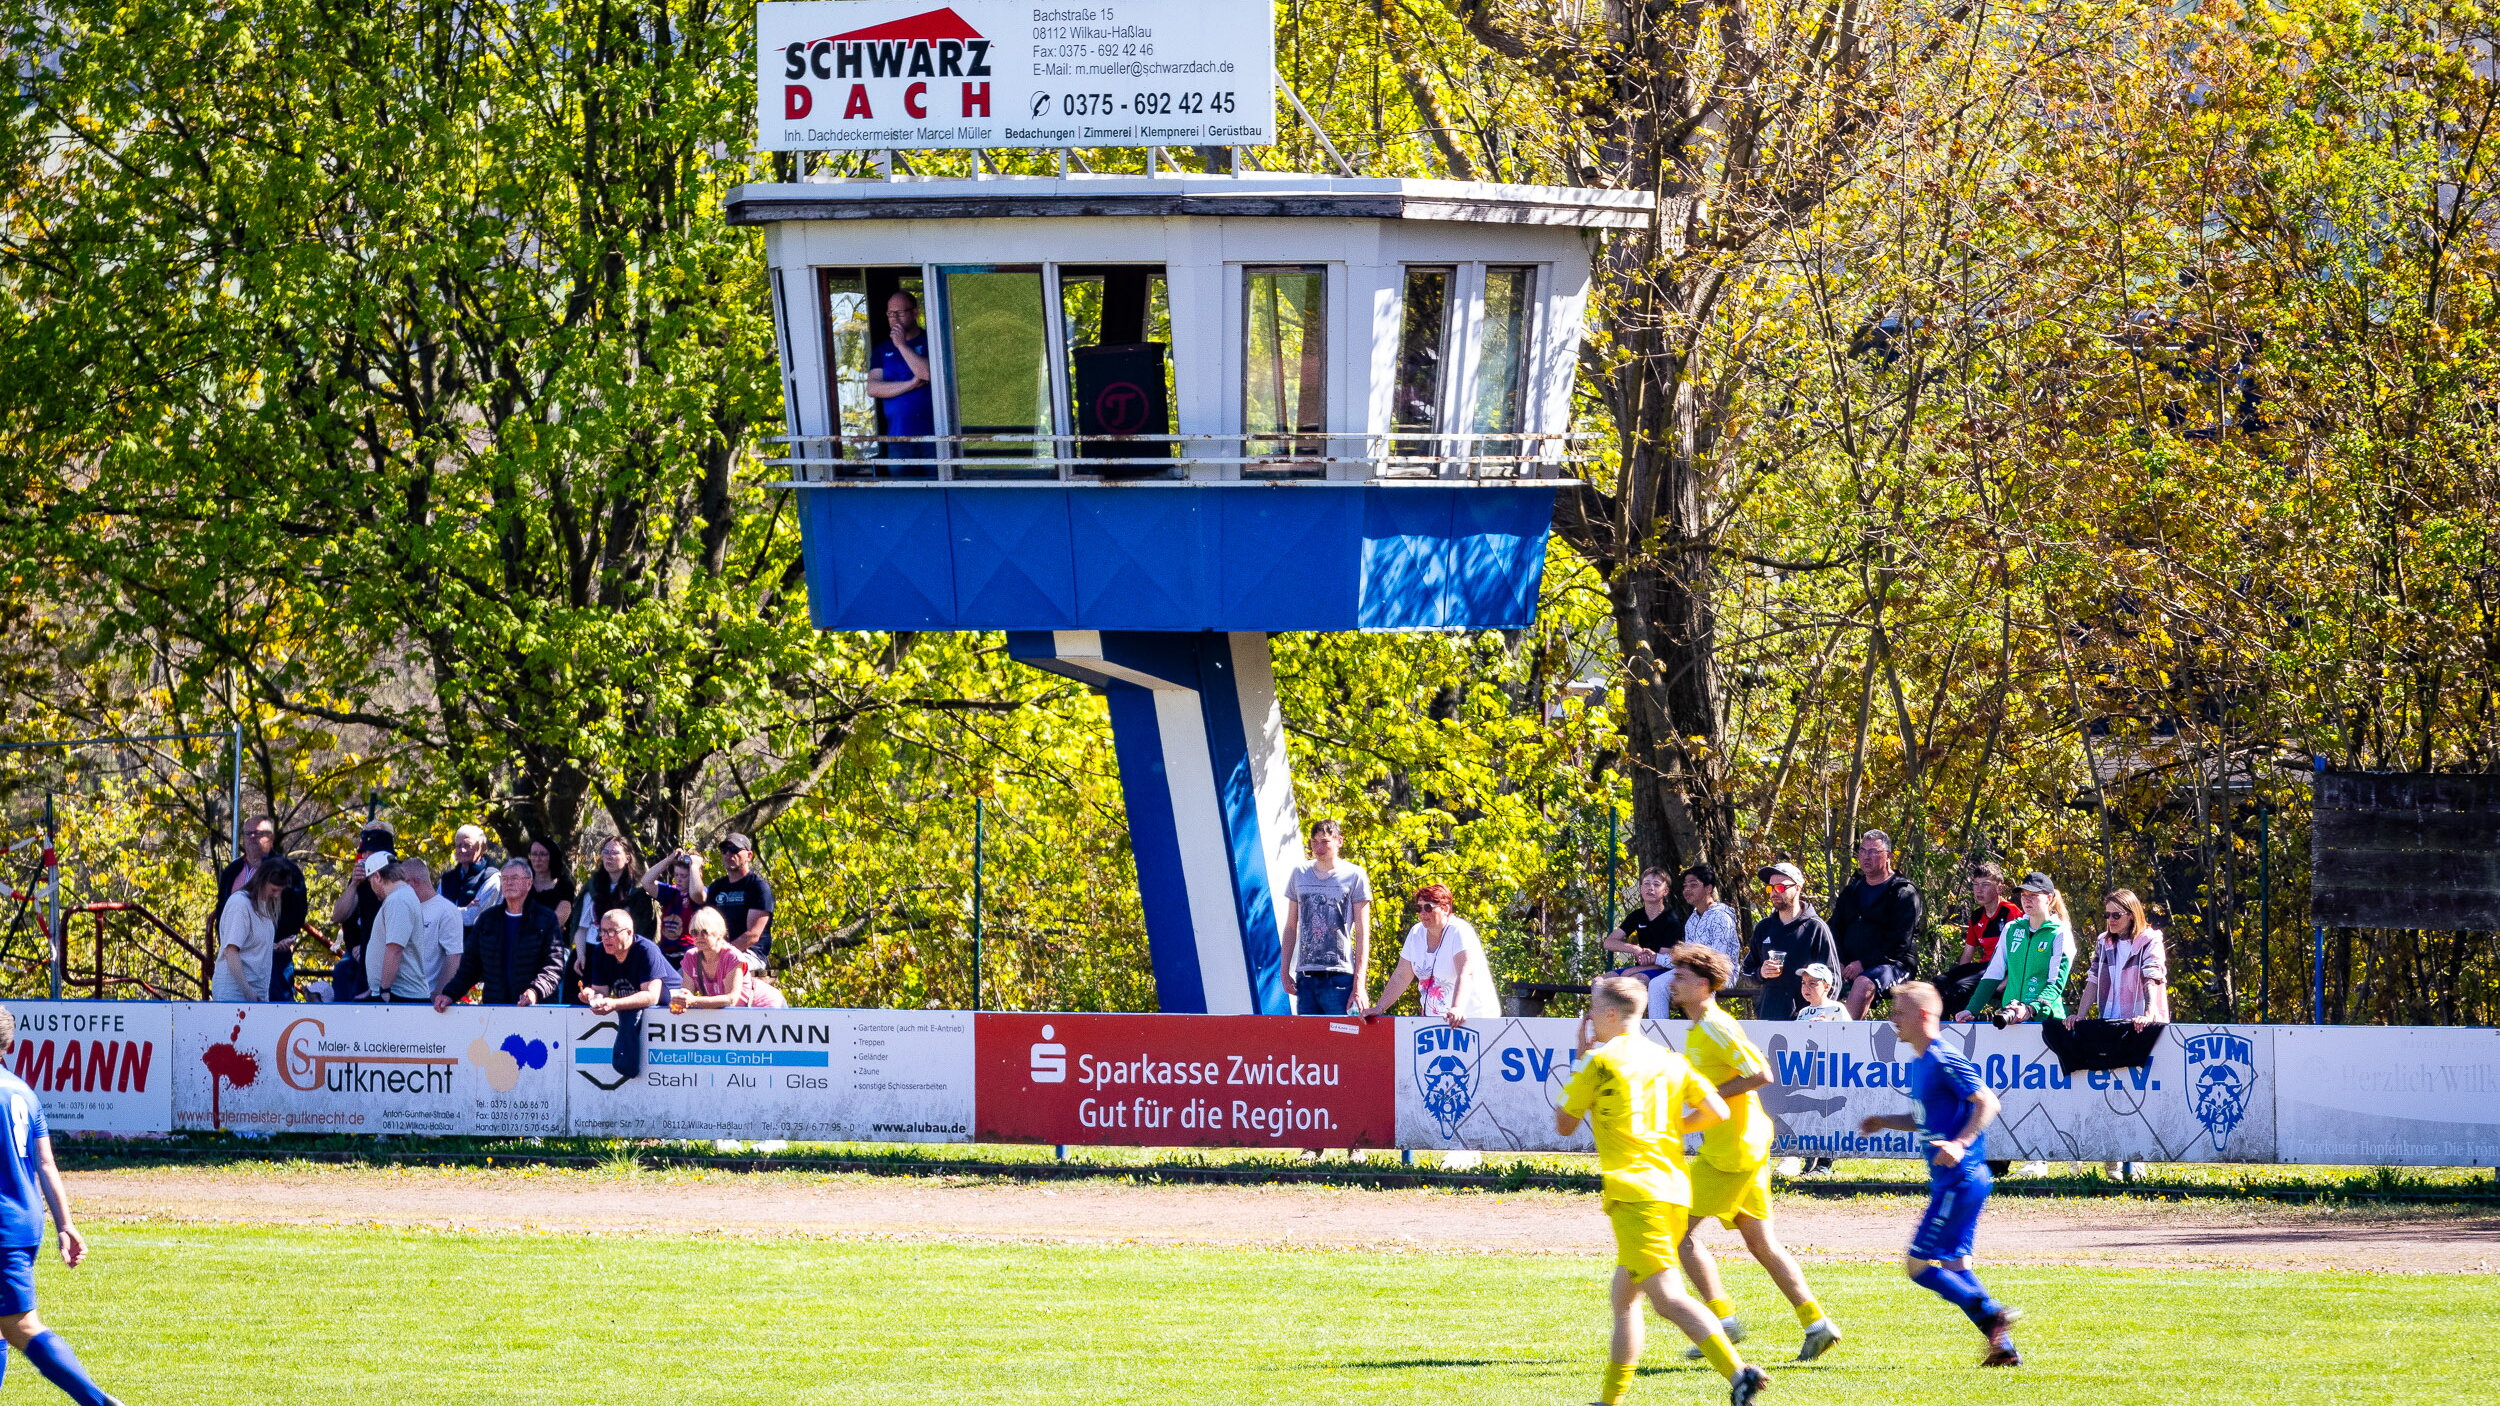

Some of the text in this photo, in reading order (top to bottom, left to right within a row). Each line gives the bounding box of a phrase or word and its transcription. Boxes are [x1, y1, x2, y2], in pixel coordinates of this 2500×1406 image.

[1033, 9, 1114, 22] Bachstraße 15
[1033, 26, 1152, 40] 08112 Wilkau-Haßlau
[1033, 45, 1056, 58] Fax:
[1059, 45, 1087, 58] 0375
[1098, 44, 1119, 57] 692
[1122, 44, 1137, 57] 42
[1139, 44, 1154, 57] 46
[785, 39, 993, 80] SCHWARZ
[1033, 61, 1234, 78] E-Mail: m.mueller@schwarzdach.de
[785, 82, 990, 120] DACH
[1063, 94, 1113, 116] 0375
[1134, 93, 1172, 116] 692
[1178, 93, 1203, 115] 42
[1210, 92, 1236, 115] 45
[784, 126, 992, 142] Inh. Dachdeckermeister Marcel Müller
[1005, 125, 1262, 140] Bedachungen Zimmerei Klempnerei Gerüstbau
[12, 1014, 124, 1032] AUSTOFFE
[858, 1024, 894, 1032] Gartentore
[896, 1024, 916, 1033] (auch
[930, 1024, 964, 1033] E-Antrieb)
[648, 1023, 830, 1044] RISSMANN
[318, 1041, 446, 1054] Maler- & Lackierermeister
[858, 1039, 885, 1047] Treppen
[649, 1051, 773, 1064] Metallbau GmbH
[2188, 1036, 2248, 1066] SVM
[1078, 1053, 1339, 1091] Sparkasse Zwickau
[1501, 1048, 1554, 1082] SV
[648, 1072, 828, 1088] Stahl Alu Glas
[858, 1082, 947, 1091] sonstige Schlosserarbeiten
[490, 1100, 508, 1108] 0375
[1629, 1073, 1668, 1134] 11
[574, 1119, 617, 1128] Kirchberger
[635, 1120, 645, 1128] 77
[662, 1120, 685, 1129] 08112
[688, 1120, 742, 1130] Wilkau-Haßlau
[780, 1122, 791, 1130] 03
[831, 1123, 842, 1132] 95
[1078, 1098, 1339, 1138] Gut für die Region.
[872, 1122, 966, 1134] www.alubau.de
[2444, 1141, 2465, 1156] Die
